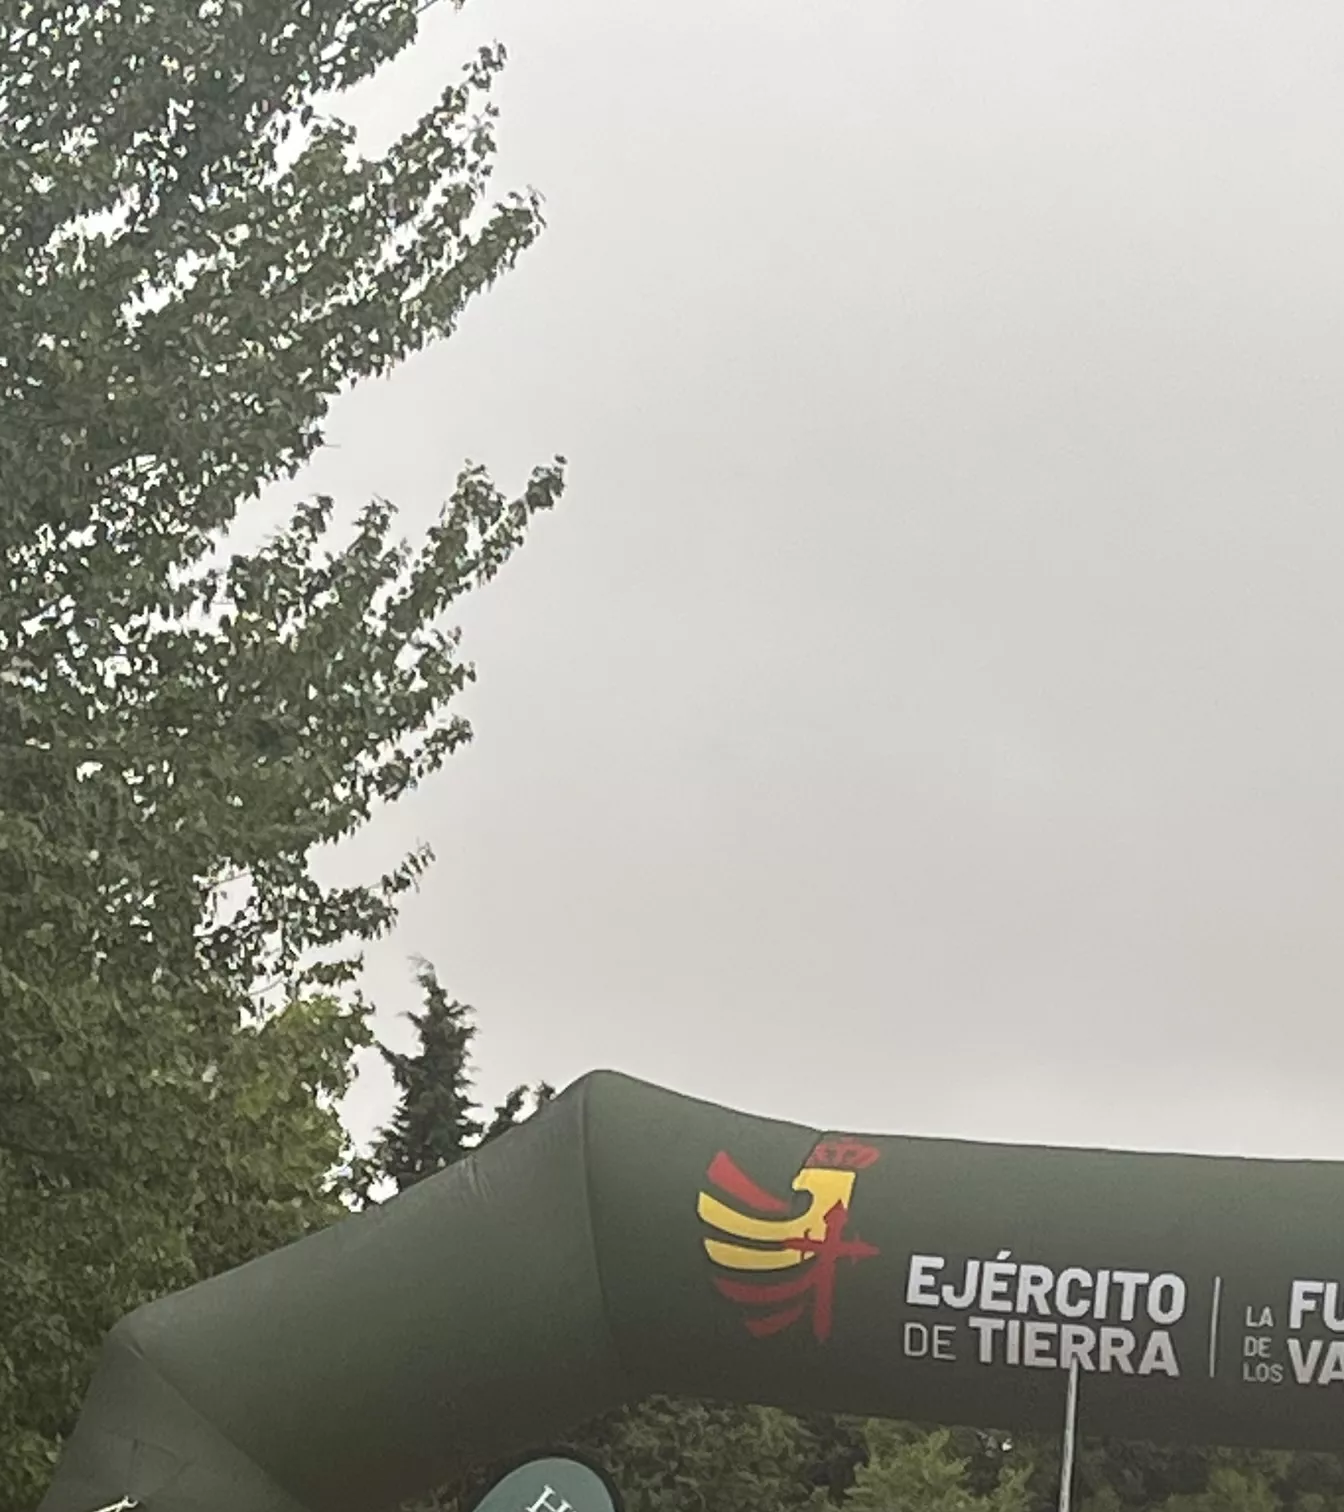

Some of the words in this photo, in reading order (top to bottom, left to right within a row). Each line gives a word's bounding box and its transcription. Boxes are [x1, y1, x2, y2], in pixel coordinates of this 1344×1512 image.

[906, 1250, 1186, 1325] EJÉRCITO
[1245, 1305, 1274, 1328] LA
[904, 1321, 957, 1361] DE
[968, 1316, 1180, 1377] TIERRA
[1244, 1335, 1273, 1358] DE
[1243, 1363, 1284, 1384] LOS
